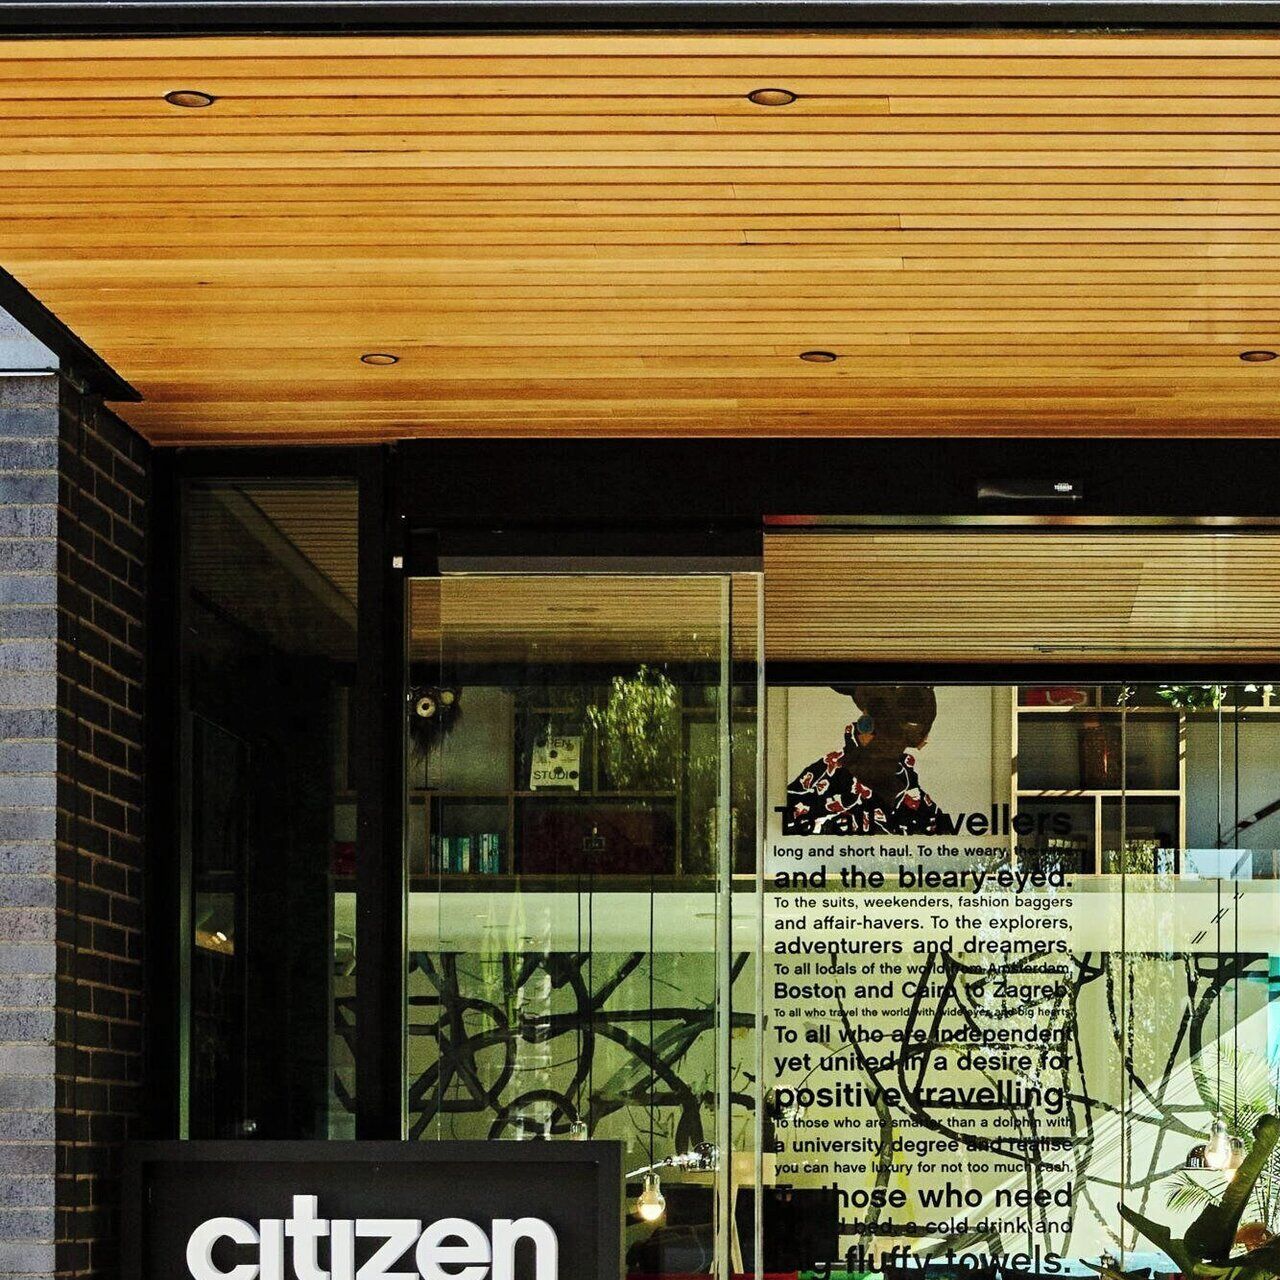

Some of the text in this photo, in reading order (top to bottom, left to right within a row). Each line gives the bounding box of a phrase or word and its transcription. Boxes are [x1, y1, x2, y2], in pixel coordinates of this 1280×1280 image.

[773, 845, 803, 860] long
[808, 845, 834, 856] and
[839, 845, 875, 856] short
[879, 845, 912, 856] haul.
[917, 845, 932, 856] To
[938, 845, 960, 856] the
[774, 865, 1072, 894] and the bleary-eyed.
[774, 897, 1072, 912] To the suits, weekenders, fashion baggers
[774, 917, 1072, 932] and affair-havers. To the explorers,
[774, 936, 1072, 954] adventurers and dreamers.
[774, 962, 790, 974] To
[794, 962, 811, 974] all
[816, 962, 857, 974] locals
[862, 962, 876, 974] of
[880, 962, 902, 974] the
[907, 962, 945, 974] wold
[774, 982, 846, 998] Boston
[854, 981, 893, 998] and
[774, 1008, 786, 1017] To
[789, 1008, 801, 1017] all
[804, 1008, 826, 1017] who
[830, 1008, 858, 1017] travel
[862, 1008, 878, 1017] the
[882, 1008, 910, 1017] world
[774, 1024, 1073, 1048] To all who ae independent
[774, 1053, 811, 1077] yet
[820, 1051, 894, 1070] united
[934, 1056, 947, 1070] a
[957, 1051, 1032, 1070] desire
[1040, 1051, 1073, 1070] for
[776, 1082, 901, 1114] positive
[794, 1117, 829, 1128] those
[834, 1117, 860, 1128] who
[866, 1119, 886, 1128] are
[891, 1117, 942, 1128] smaer
[946, 1117, 976, 1128] than
[980, 1119, 988, 1128] a
[1046, 1117, 1072, 1128] with
[775, 1140, 785, 1152] a
[792, 1137, 884, 1157] university
[891, 1136, 959, 1157] degree
[774, 1164, 798, 1176] you
[804, 1164, 828, 1173] can
[834, 1162, 866, 1172] have
[872, 1162, 913, 1176] luxury
[918, 1162, 936, 1172] for
[942, 1162, 962, 1172] not
[968, 1162, 989, 1172] too
[994, 1162, 1030, 1172] much
[918, 1182, 983, 1208] who
[996, 1182, 1072, 1208] need
[926, 1217, 968, 1234] cold
[976, 1217, 1028, 1234] drink
[1036, 1217, 1072, 1234] and
[946, 1244, 1071, 1274] towels.
